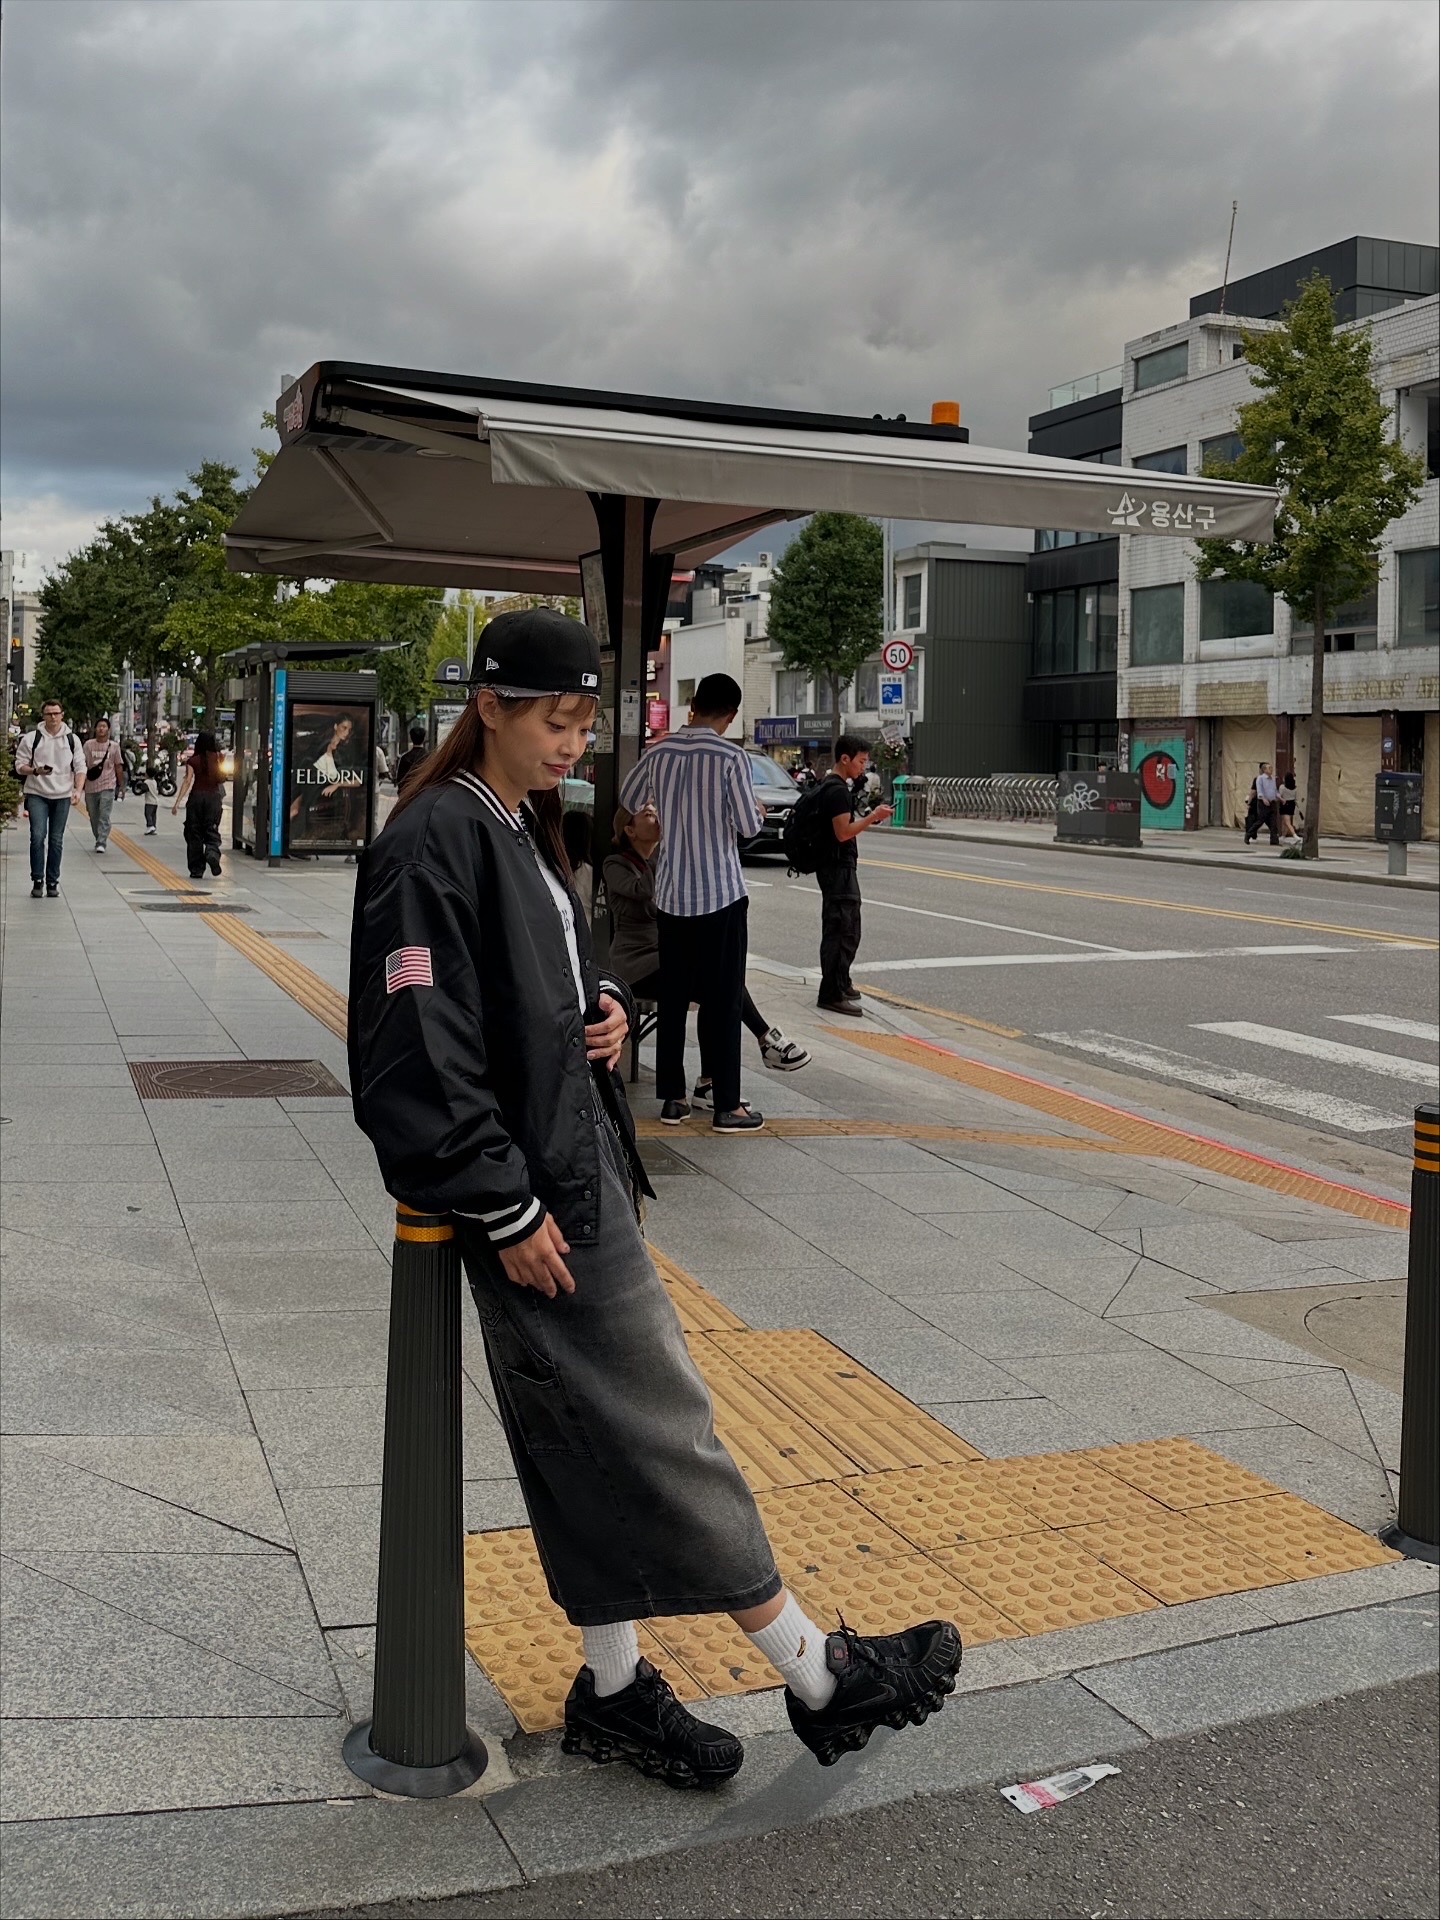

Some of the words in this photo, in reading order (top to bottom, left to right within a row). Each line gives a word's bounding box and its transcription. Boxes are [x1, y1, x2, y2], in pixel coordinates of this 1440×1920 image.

[1151, 500, 1216, 530] 용산구
[890, 648, 906, 664] 50
[759, 724, 773, 739] ITALY
[291, 768, 364, 785] ELBORN
